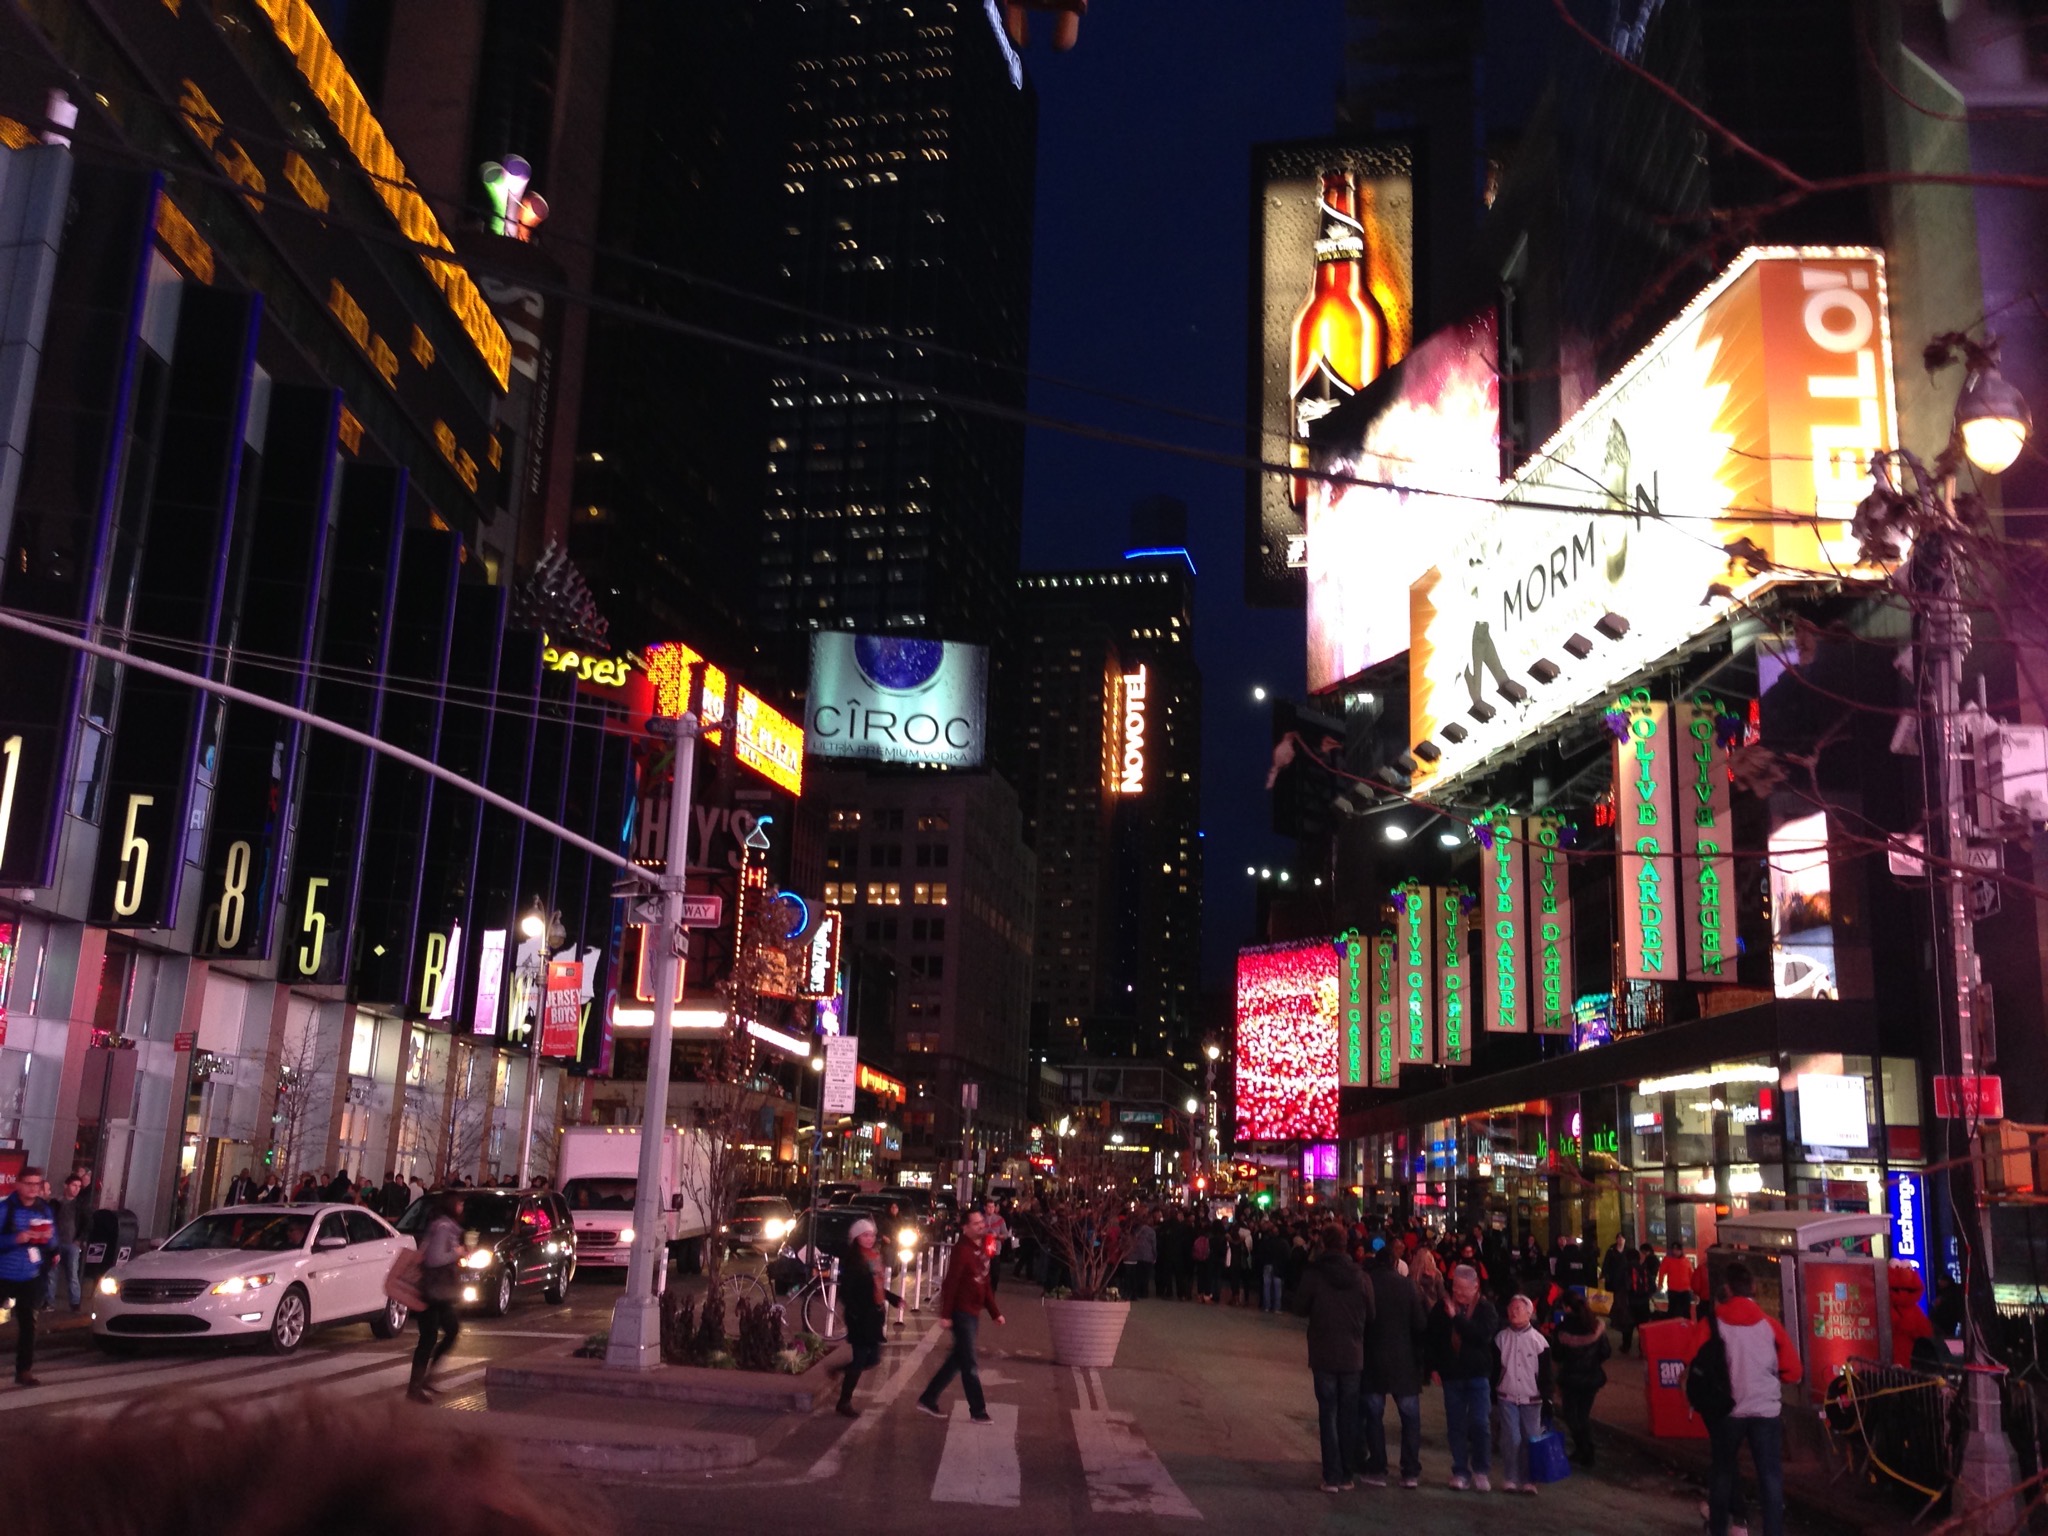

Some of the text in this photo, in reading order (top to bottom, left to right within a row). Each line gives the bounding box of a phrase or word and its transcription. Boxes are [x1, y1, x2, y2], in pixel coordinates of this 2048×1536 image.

[812, 741, 967, 761] ULTRA PREMIUM VODKA
[813, 698, 970, 749] CÎROC
[1120, 663, 1147, 793] NOVOTEL
[1632, 717, 1662, 973] OLIVE GARDEN
[683, 904, 711, 918] WAY
[1494, 825, 1515, 1026] OLIVE GARDEN
[546, 989, 581, 1006] JERSEY
[551, 1006, 577, 1024] BOYS
[1347, 942, 1362, 1083] OLIVE GARDEN
[1406, 894, 1424, 1060] OLIVE GARDEN
[1897, 1173, 1915, 1255] Exchange
